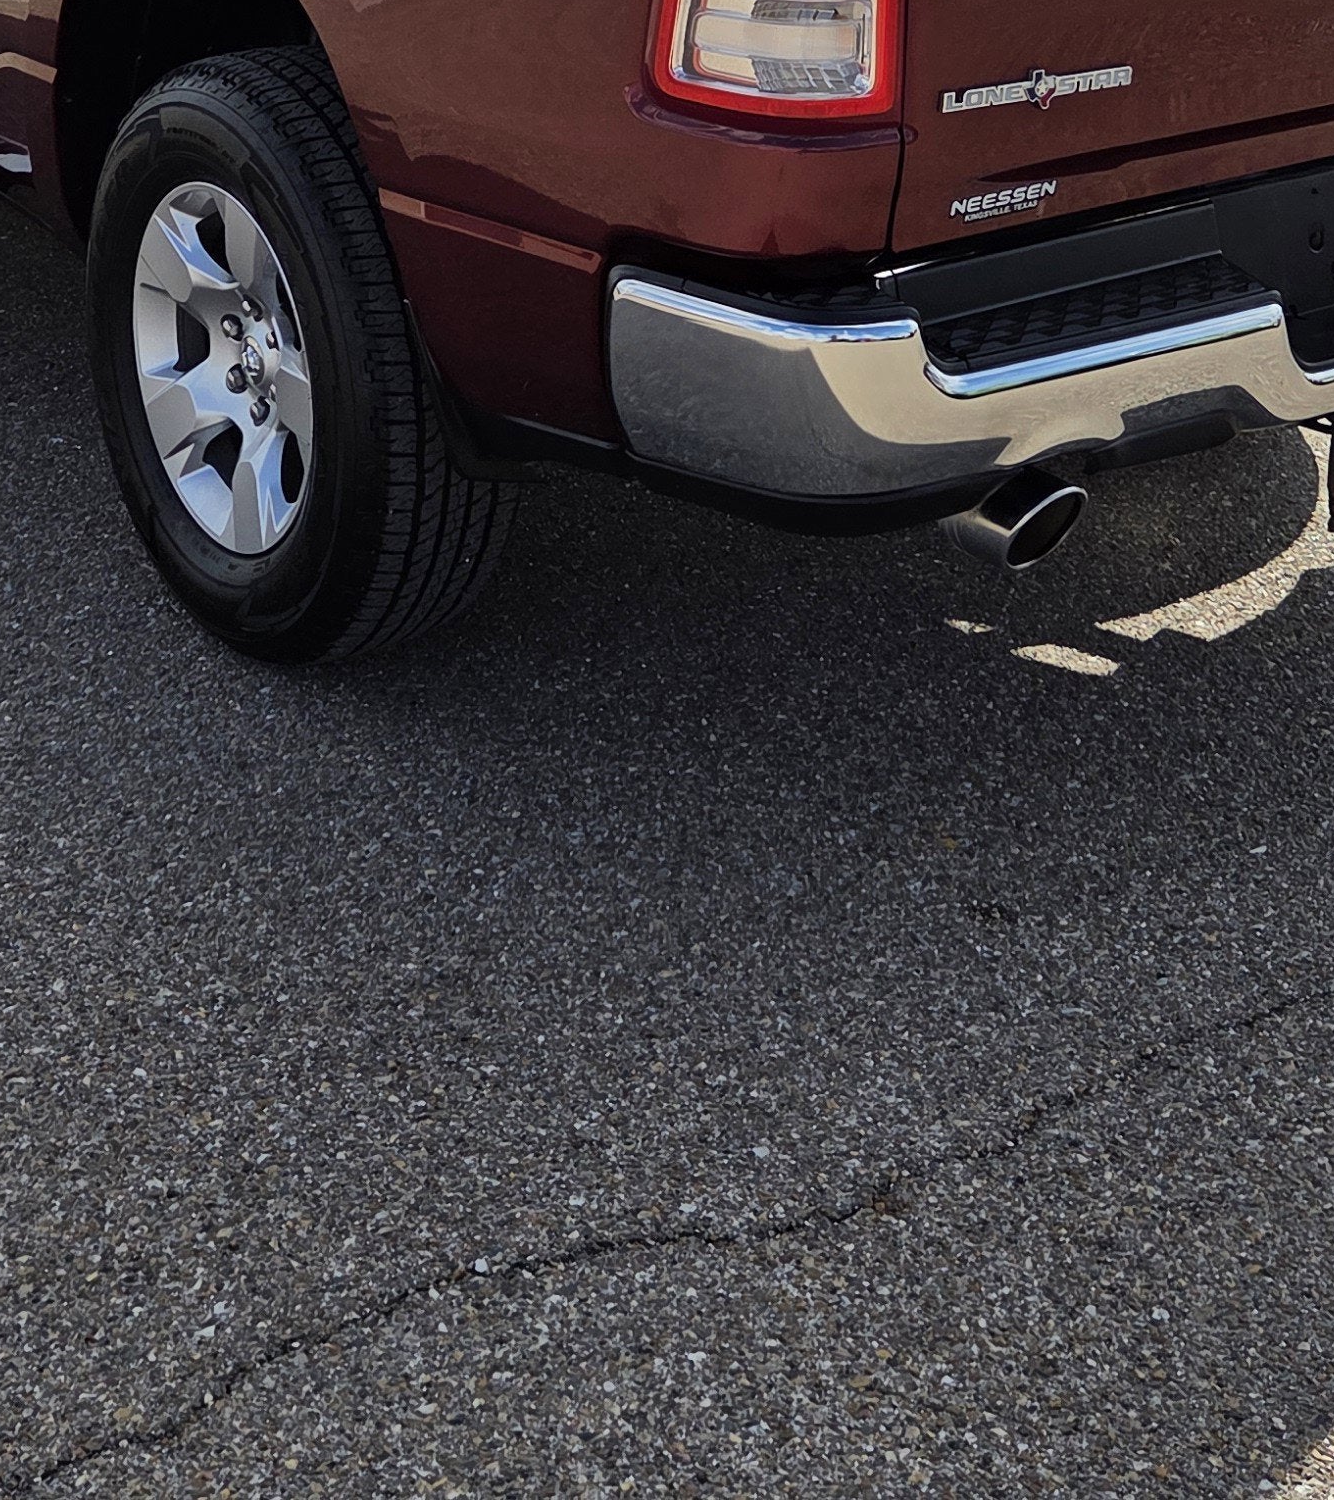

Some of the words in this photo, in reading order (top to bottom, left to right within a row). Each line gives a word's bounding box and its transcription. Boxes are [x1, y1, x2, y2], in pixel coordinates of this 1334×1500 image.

[942, 82, 1029, 113] LONE
[1054, 65, 1133, 97] STAR
[949, 179, 1058, 217] NEESSEN
[1013, 200, 1039, 212] TEXAS
